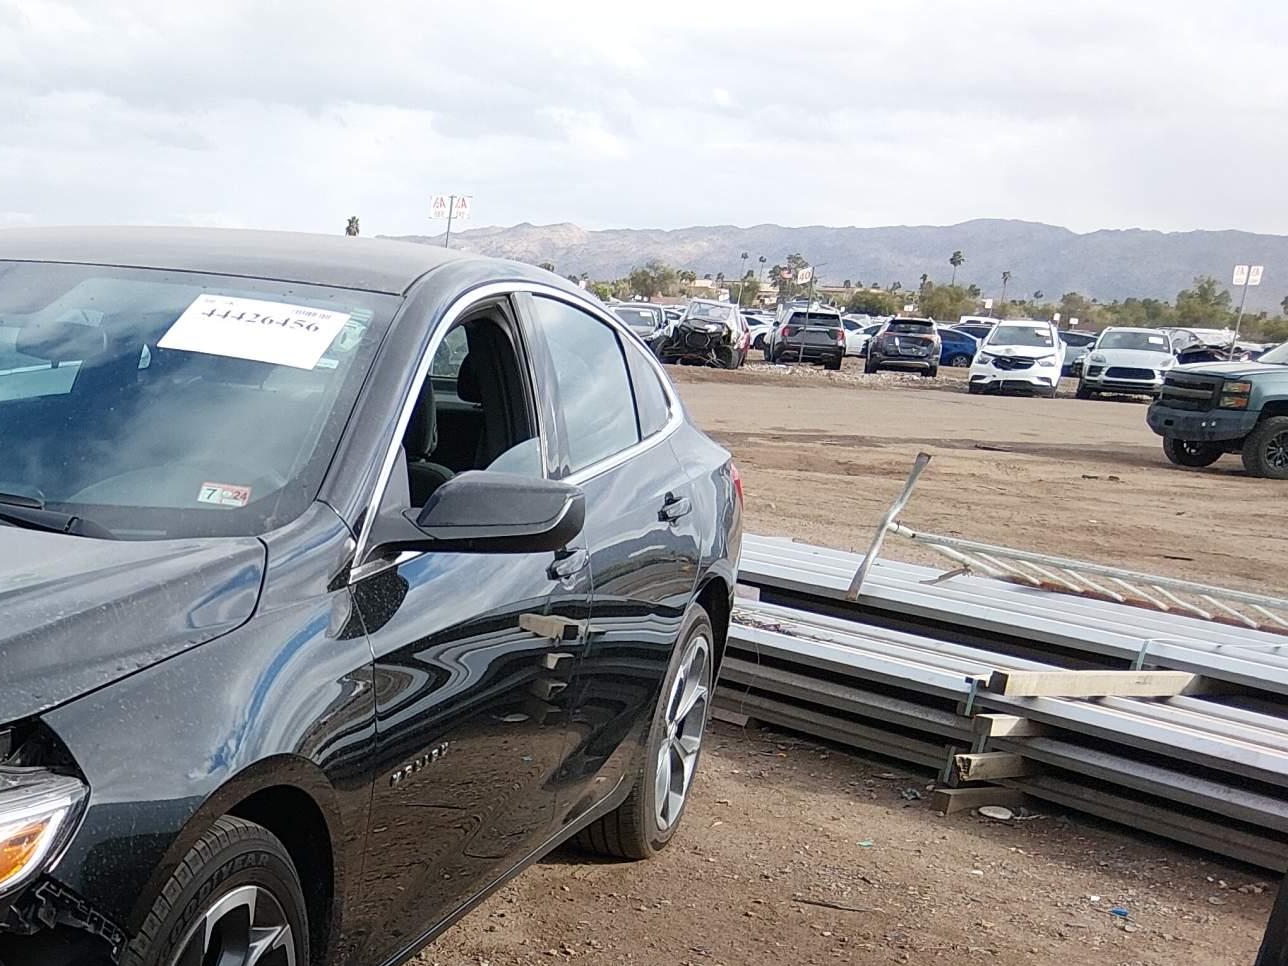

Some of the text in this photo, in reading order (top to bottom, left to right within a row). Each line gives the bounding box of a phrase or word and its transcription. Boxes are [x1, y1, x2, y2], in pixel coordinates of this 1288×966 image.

[201, 308, 320, 333] 44426456
[206, 488, 248, 501] 7 24
